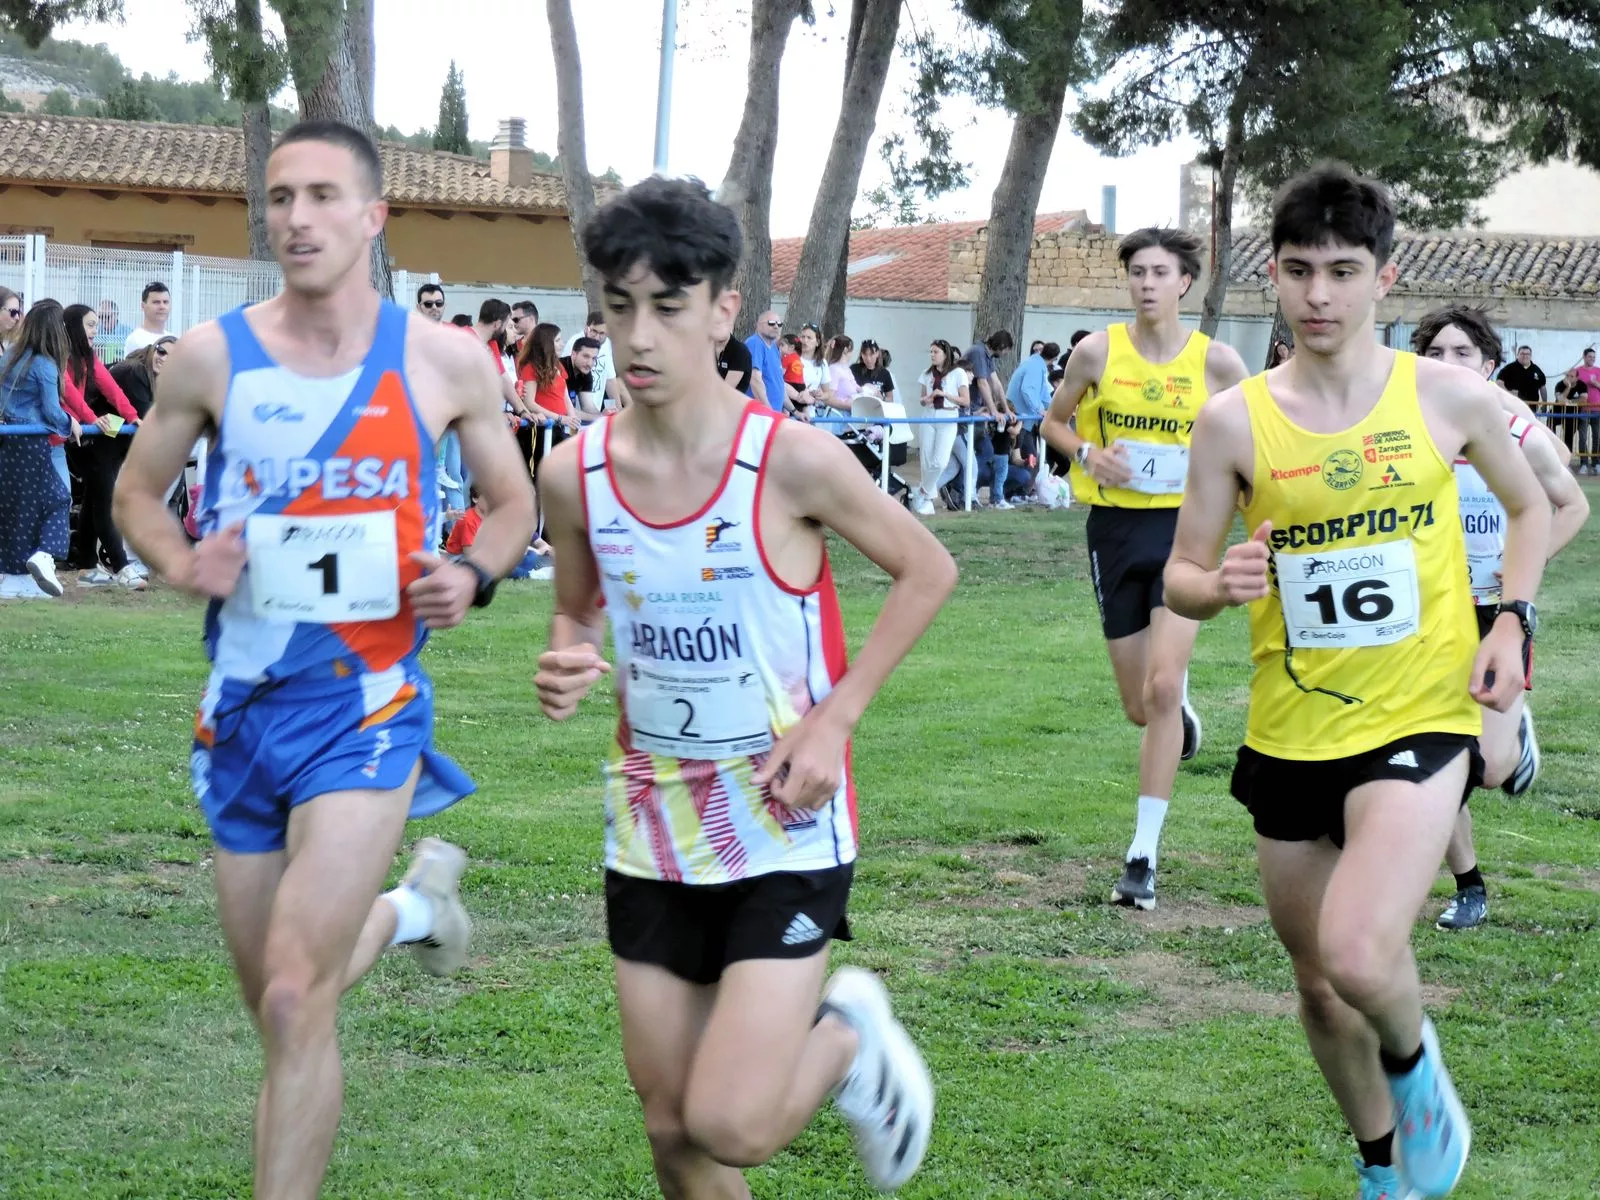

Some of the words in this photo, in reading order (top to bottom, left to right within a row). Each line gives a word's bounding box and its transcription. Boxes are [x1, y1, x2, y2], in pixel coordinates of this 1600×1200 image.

[1378, 443, 1412, 453] Zaragoza
[1141, 457, 1156, 478] 4
[1271, 500, 1435, 550] SCORPIO-71
[307, 552, 339, 595] 1
[1315, 552, 1384, 574] ARAGÓN
[647, 592, 677, 603] CAJA
[681, 591, 723, 604] RURAL
[1304, 579, 1394, 625] 16
[673, 698, 702, 739] 2
